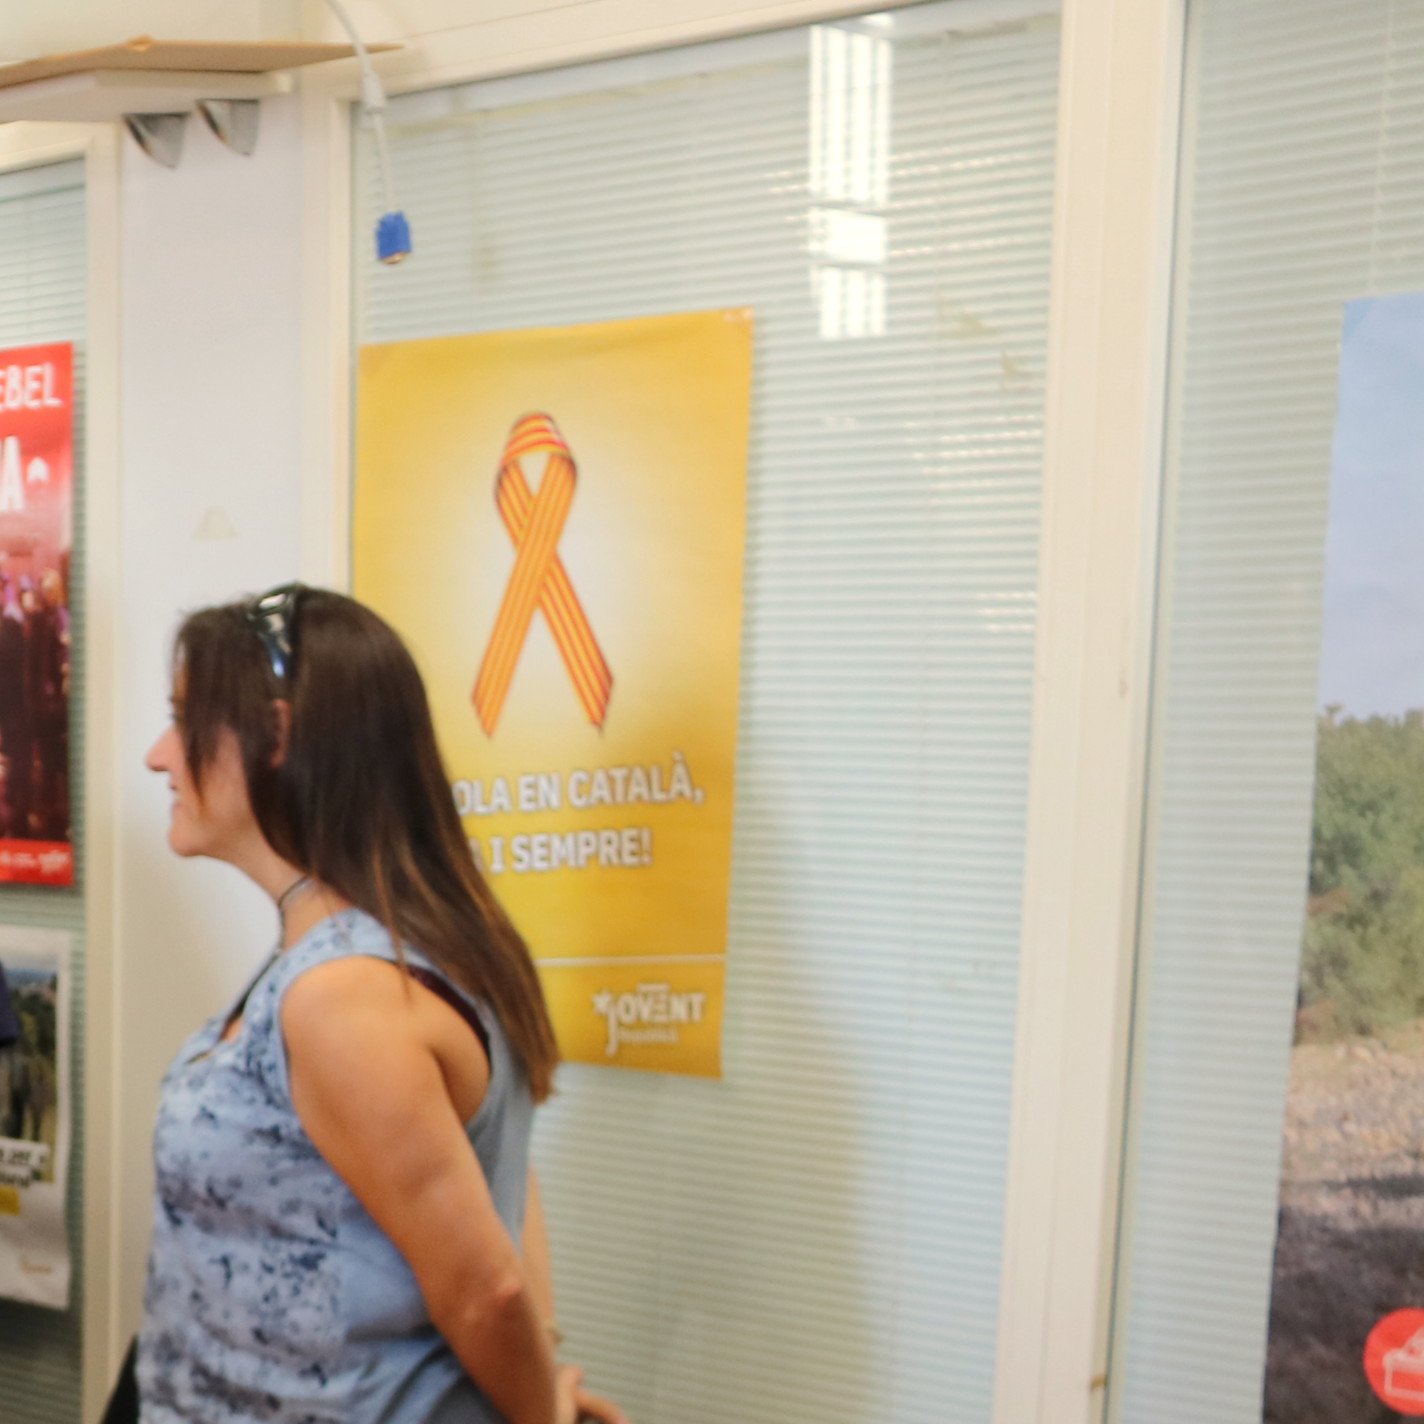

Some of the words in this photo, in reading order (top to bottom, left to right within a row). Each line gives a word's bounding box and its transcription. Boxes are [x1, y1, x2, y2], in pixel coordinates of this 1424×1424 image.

[452, 776, 513, 816] OLA
[518, 773, 562, 812] EN
[567, 750, 706, 808] CATALÀ,
[489, 837, 507, 874] I
[511, 827, 653, 873] SEMPRE!
